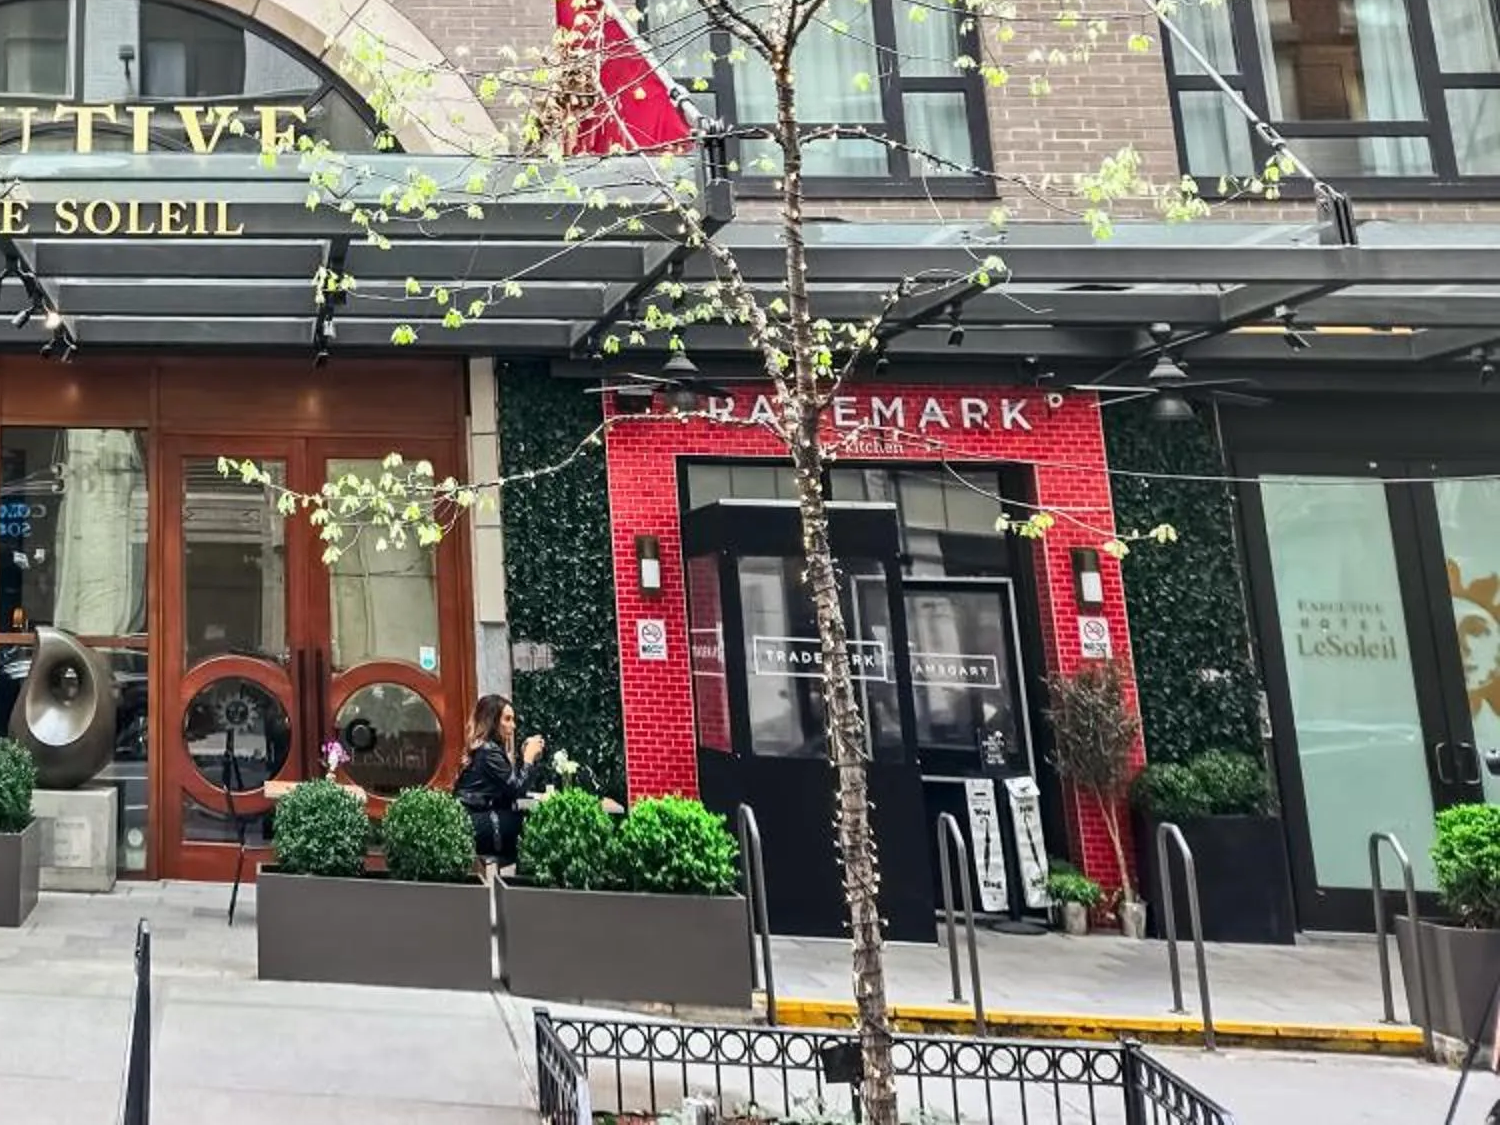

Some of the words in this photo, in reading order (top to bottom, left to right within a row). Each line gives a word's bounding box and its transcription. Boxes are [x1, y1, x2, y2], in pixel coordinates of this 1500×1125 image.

[55, 199, 245, 236] SOLEIL
[709, 395, 1033, 431] RAEMARK
[766, 650, 875, 668] TRADERK
[1296, 634, 1398, 660] LeSoleil
